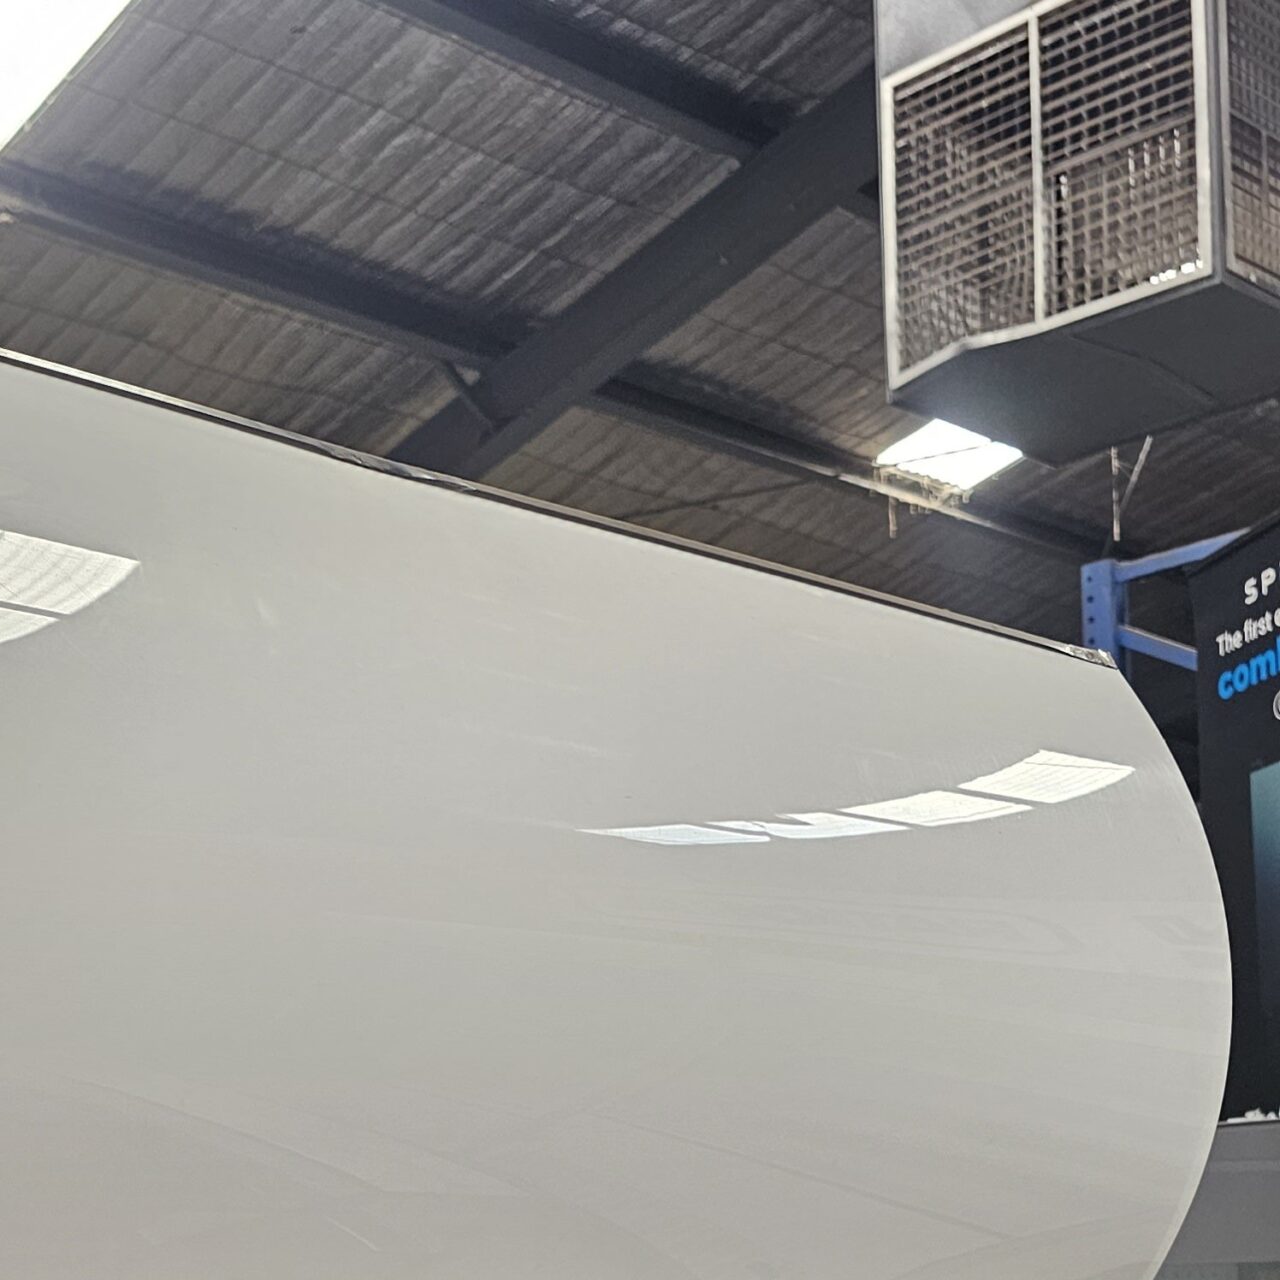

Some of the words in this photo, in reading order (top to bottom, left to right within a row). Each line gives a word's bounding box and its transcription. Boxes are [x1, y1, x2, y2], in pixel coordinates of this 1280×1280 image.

[1244, 562, 1280, 605] SP
[1216, 630, 1243, 656] The
[1243, 610, 1273, 644] first
[1217, 634, 1280, 700] com
